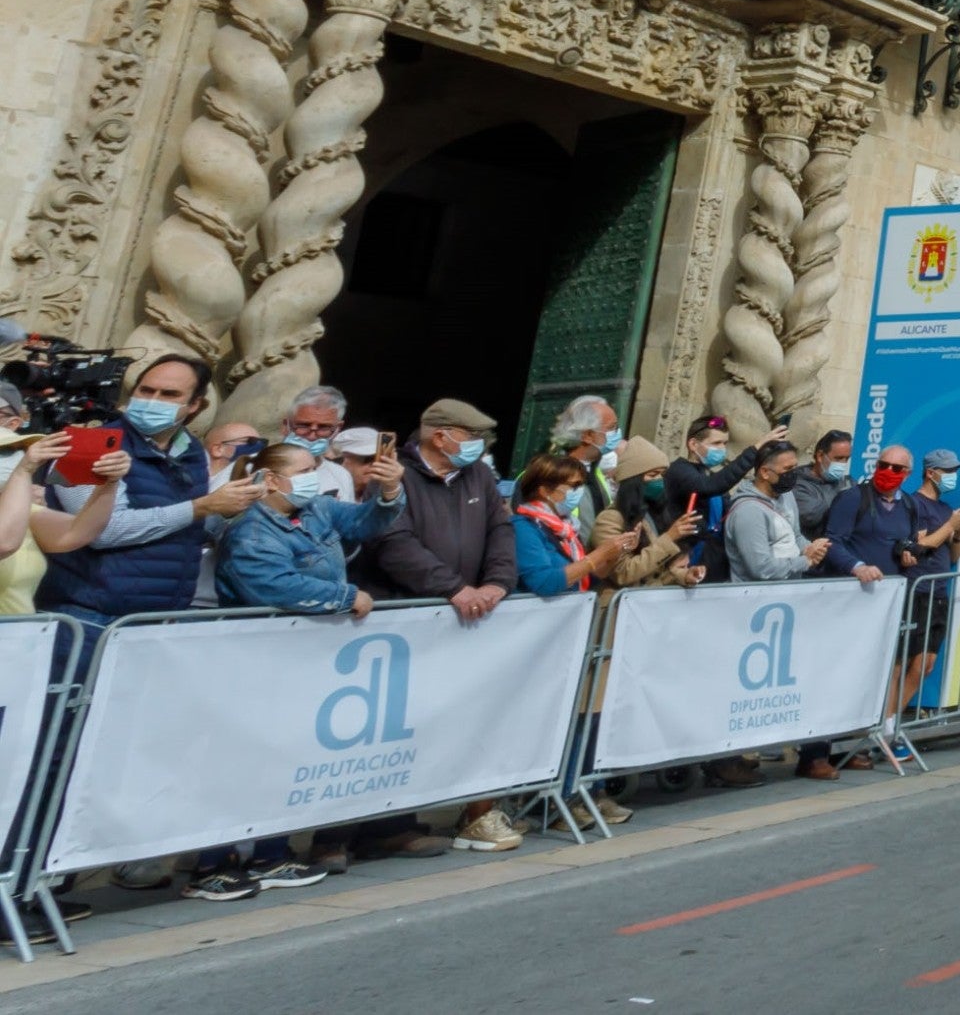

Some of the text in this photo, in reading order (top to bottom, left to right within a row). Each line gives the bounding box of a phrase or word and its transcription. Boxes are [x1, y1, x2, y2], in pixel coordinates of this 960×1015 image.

[900, 324, 948, 335] ALICANTE
[730, 691, 801, 714] DIPUTACIÓN
[728, 709, 801, 732] DE ALICANTE
[293, 747, 417, 783] DIPUTACIÓN
[287, 770, 411, 806] DE ALICANTE
